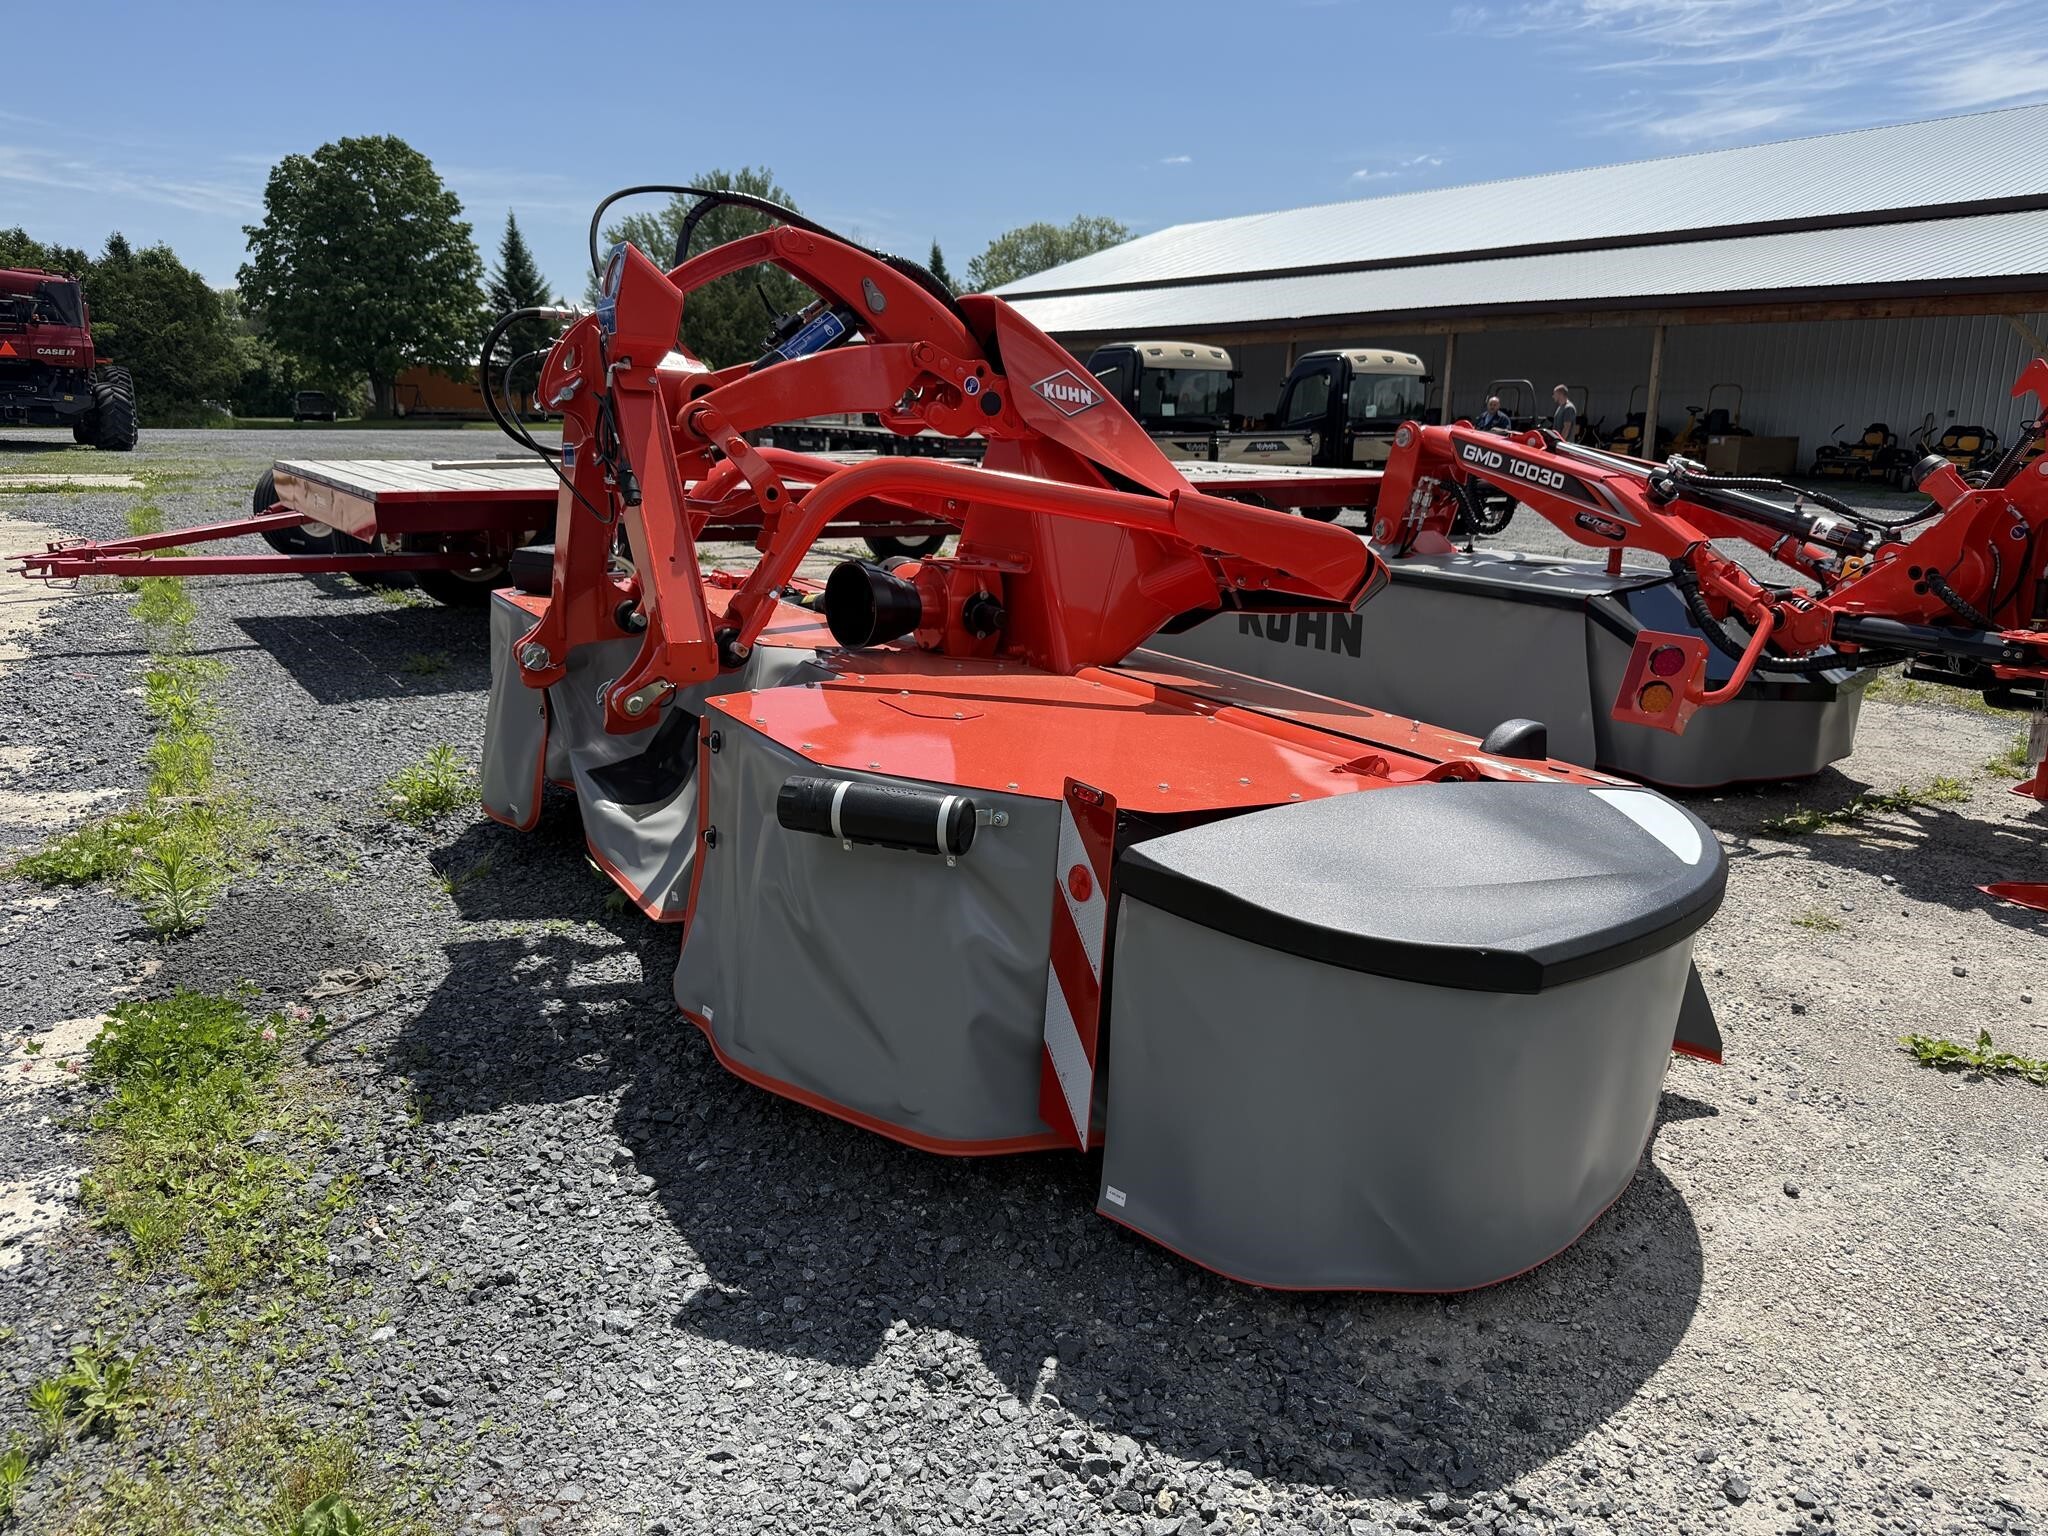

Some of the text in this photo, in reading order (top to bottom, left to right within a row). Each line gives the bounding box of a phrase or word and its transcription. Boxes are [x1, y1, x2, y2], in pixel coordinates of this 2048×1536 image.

[36, 347, 65, 356] CASE
[1043, 382, 1092, 405] KUHN
[1463, 444, 1565, 490] GMD 10030
